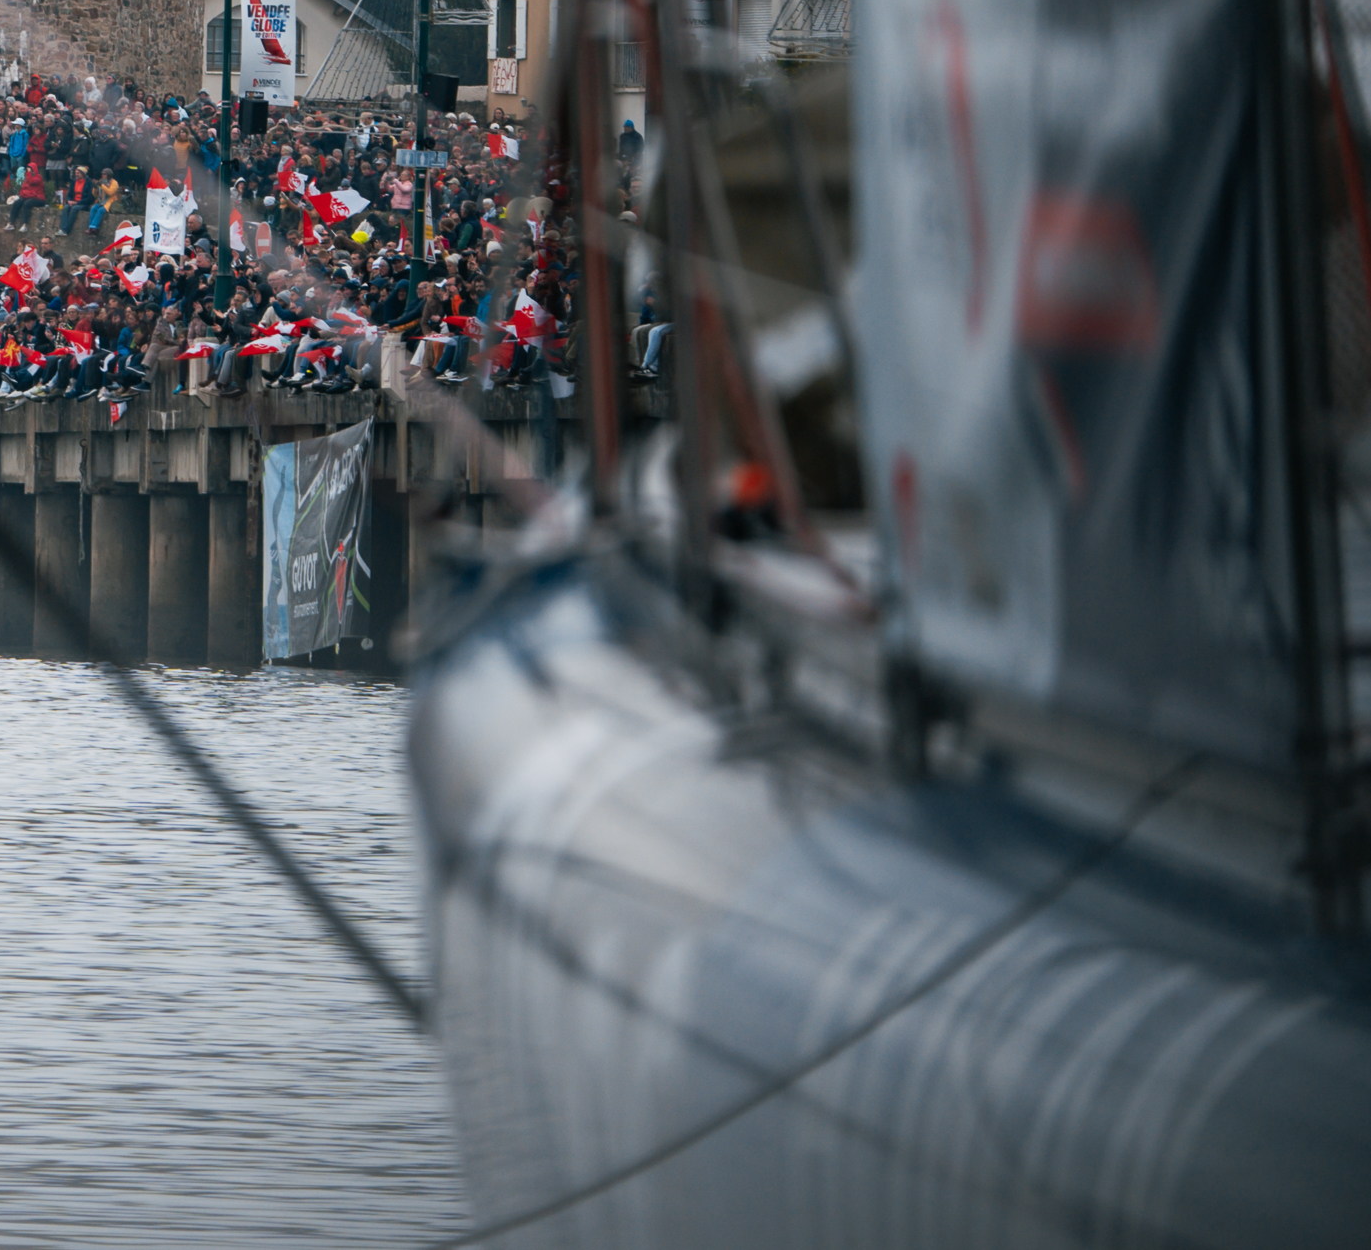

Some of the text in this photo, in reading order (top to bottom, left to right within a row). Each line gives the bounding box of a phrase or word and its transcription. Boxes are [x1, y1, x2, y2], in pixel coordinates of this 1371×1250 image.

[247, 4, 290, 19] VENDÉE
[251, 19, 287, 32] GLOBE
[292, 552, 319, 594] GUYOT
